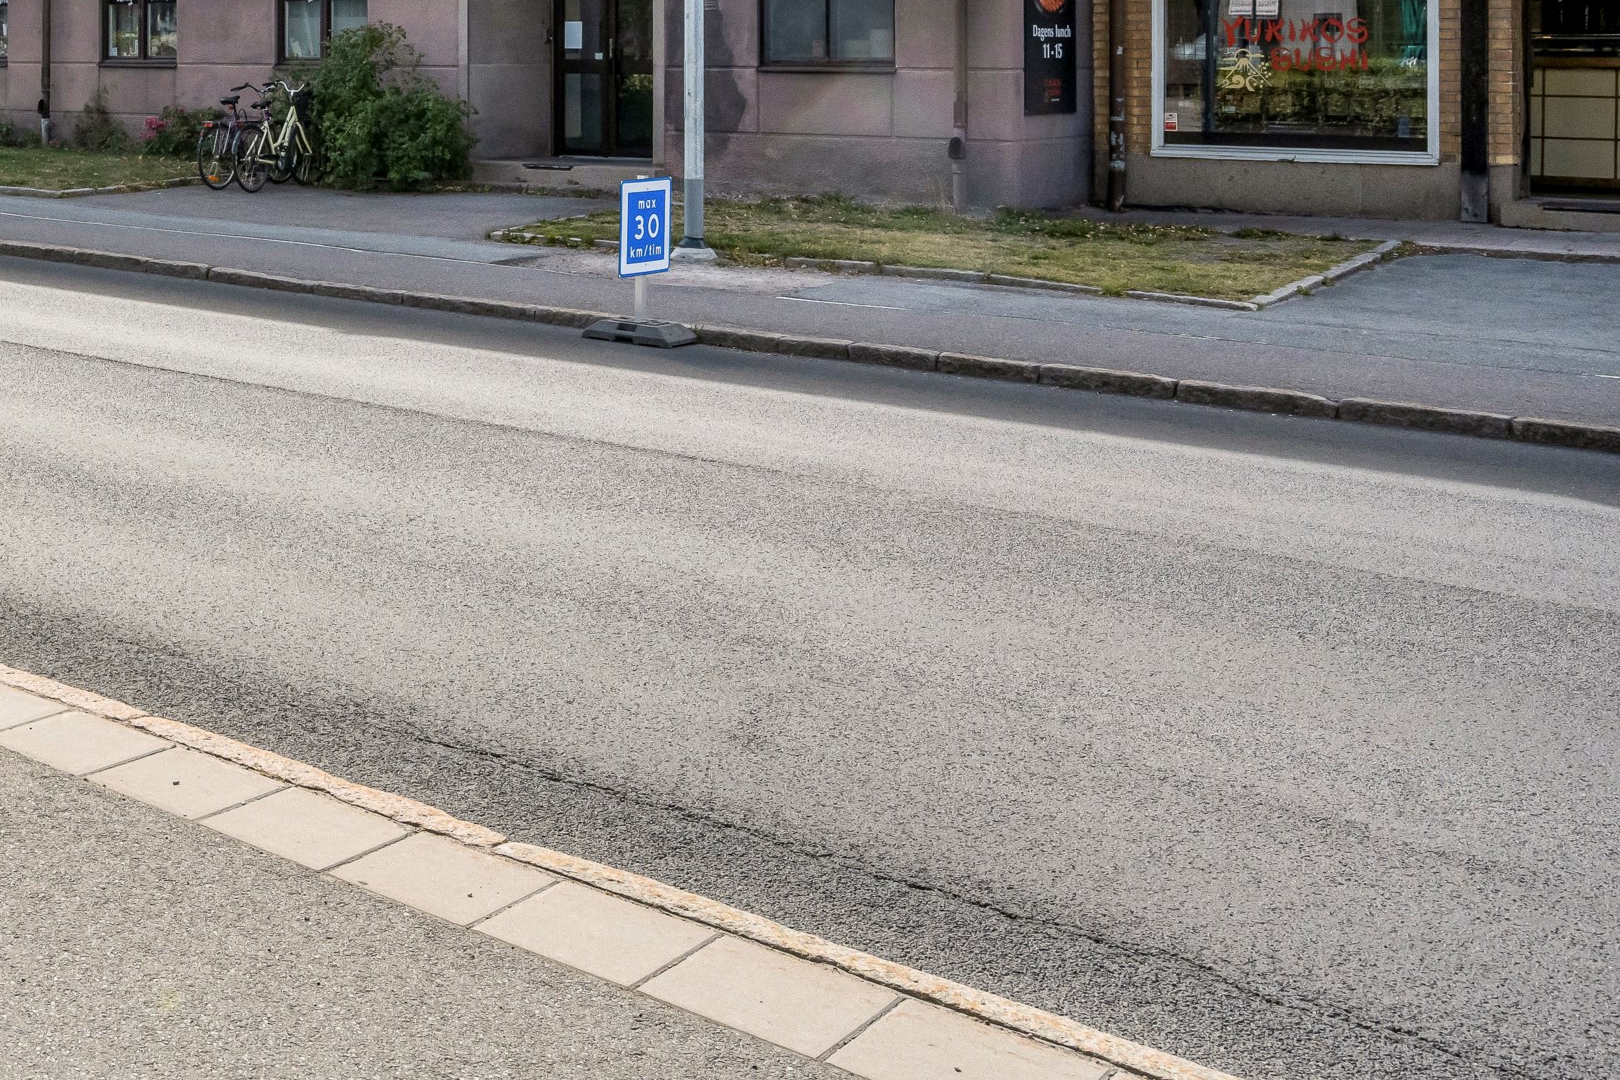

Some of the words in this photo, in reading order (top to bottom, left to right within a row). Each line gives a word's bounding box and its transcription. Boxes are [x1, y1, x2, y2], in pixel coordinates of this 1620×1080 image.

[1032, 24, 1054, 41] Dagens
[1055, 24, 1071, 38] lunch
[1221, 15, 1369, 48] YUKIKOS
[1269, 46, 1369, 71] SUSHI
[638, 199, 657, 210] max
[634, 213, 660, 240] 30
[630, 243, 662, 259] km/tim
